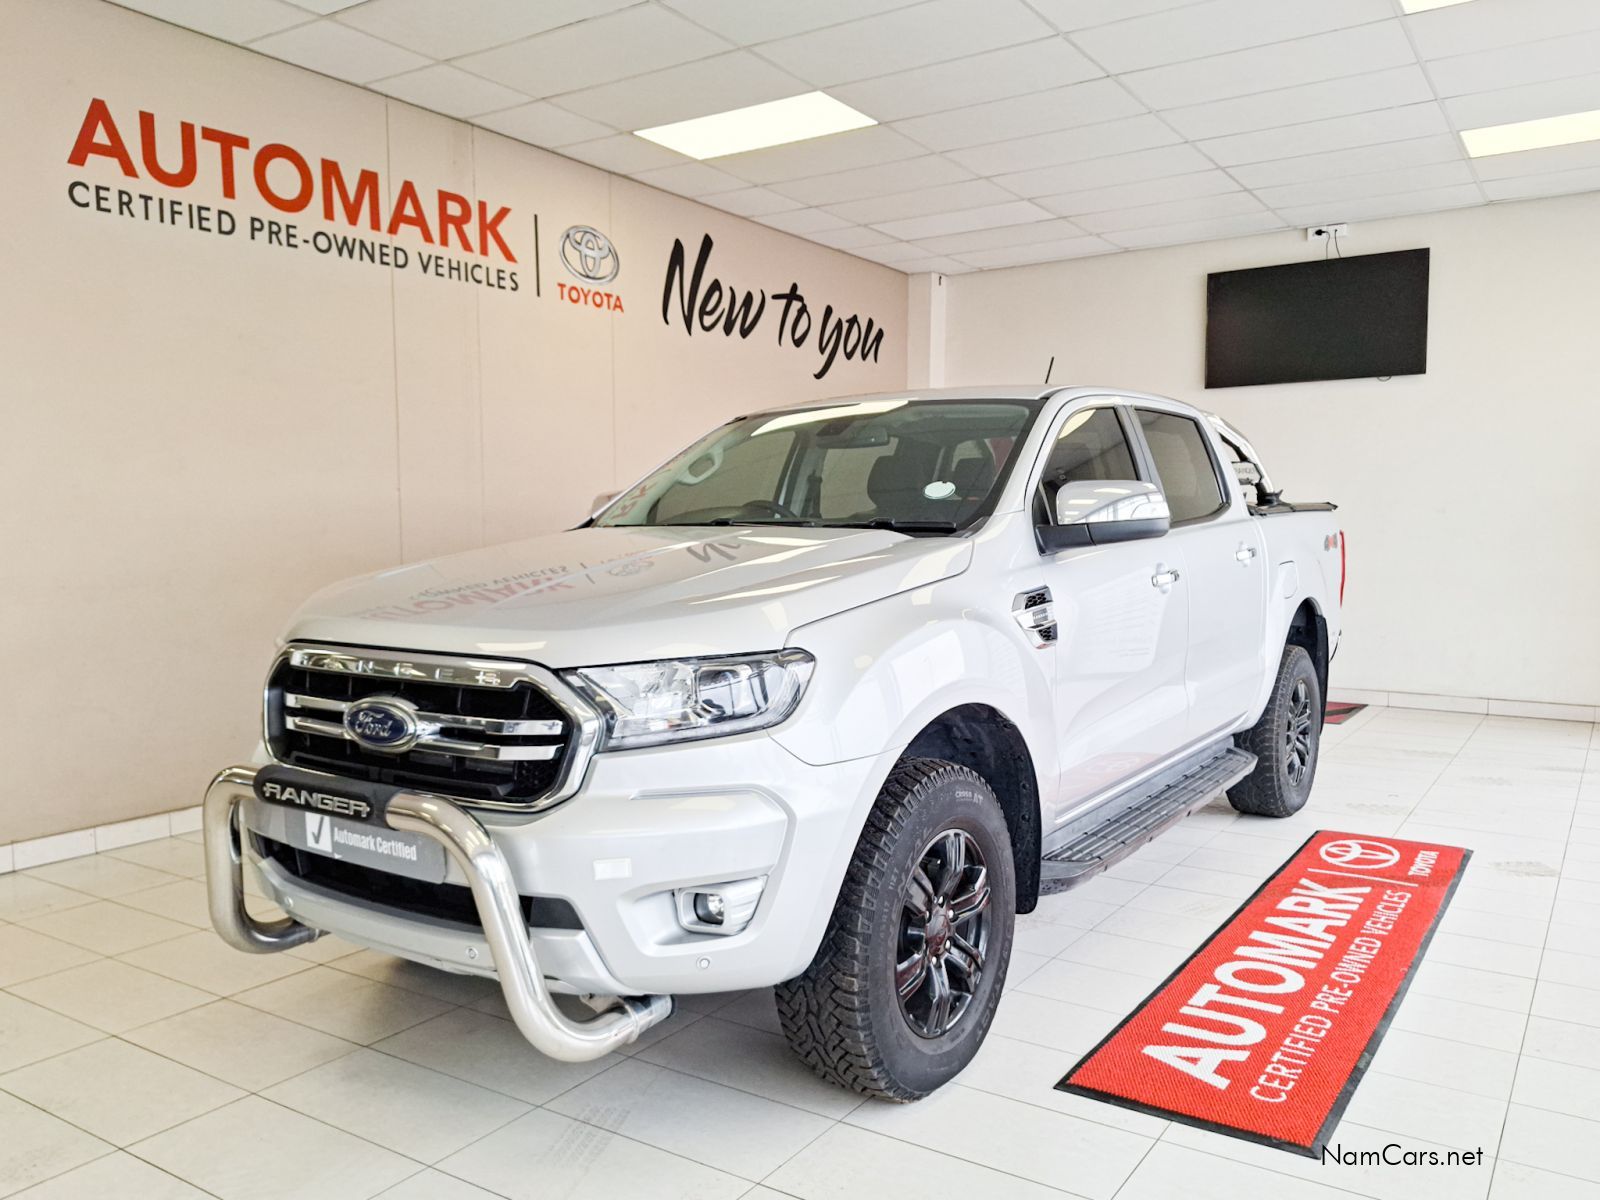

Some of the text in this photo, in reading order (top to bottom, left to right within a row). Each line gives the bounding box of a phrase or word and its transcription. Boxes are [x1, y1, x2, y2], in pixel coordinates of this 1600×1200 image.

[67, 97, 518, 263] AUTOMARK
[67, 180, 519, 292] CERTIFIED PRE-OWNED VEHICLES
[557, 282, 624, 314] TOYOTA
[661, 233, 885, 380] New to you
[354, 710, 392, 739] Ford
[263, 782, 371, 818] RANGER
[334, 827, 417, 861] Automark Certified
[1407, 850, 1439, 878] TOYOTA
[1141, 879, 1371, 1091] AUTOMARK
[1250, 889, 1412, 1103] CERTIFIED PRE-OWNED VEHICLES
